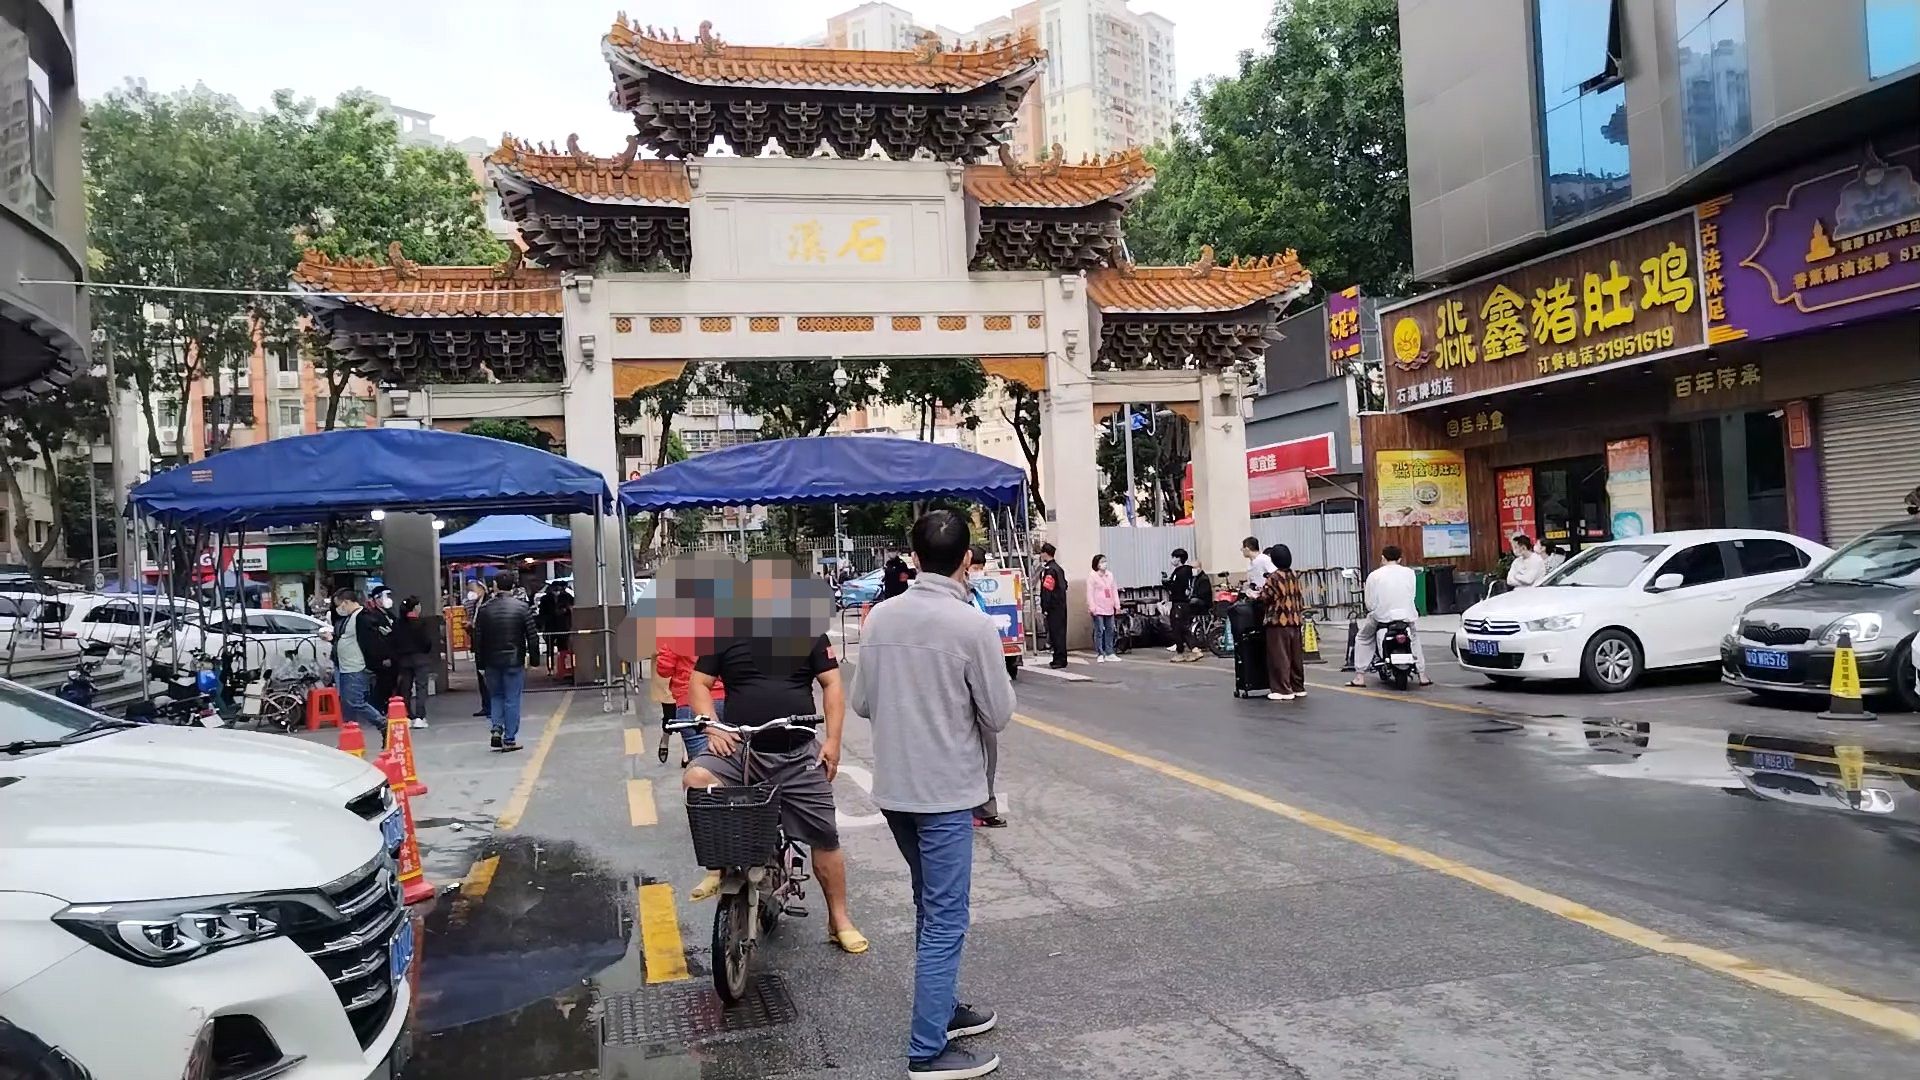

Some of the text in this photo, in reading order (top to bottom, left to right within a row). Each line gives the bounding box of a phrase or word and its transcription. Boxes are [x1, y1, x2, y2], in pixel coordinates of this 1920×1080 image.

[1701, 223, 1726, 322] 古法沐足
[1537, 325, 1675, 374] 订餐电话 31951619
[1396, 376, 1453, 404] 石溪牌坊店
[1674, 363, 1761, 398] 百年传承
